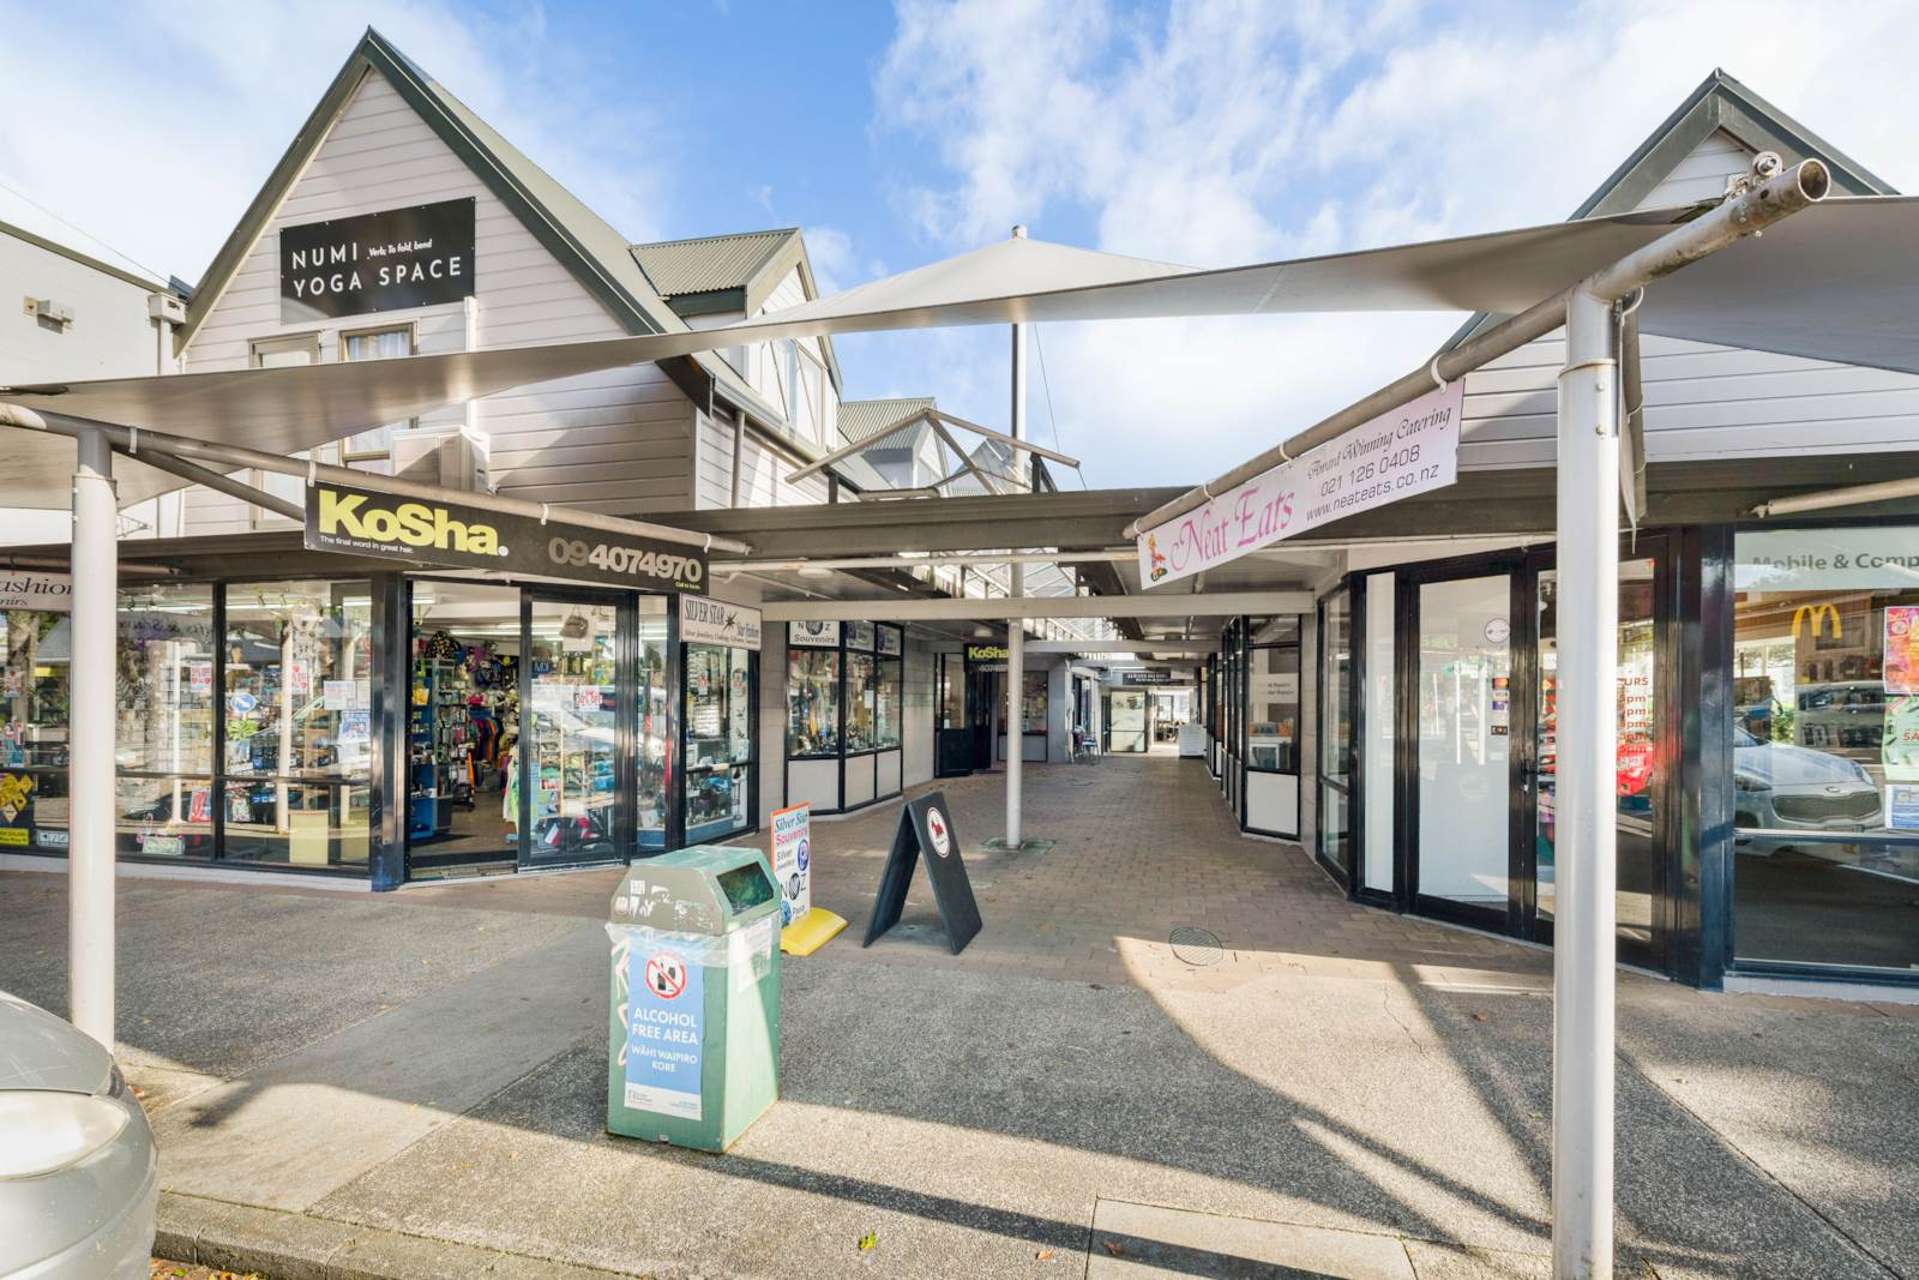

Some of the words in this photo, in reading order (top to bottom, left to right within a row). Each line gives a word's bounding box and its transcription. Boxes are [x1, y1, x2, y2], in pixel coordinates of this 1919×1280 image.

[292, 242, 357, 270] NUMI
[293, 272, 362, 298] YOGA
[379, 256, 462, 286] SPACE
[1342, 431, 1394, 461] Winning
[1396, 407, 1452, 440] Catering
[1320, 475, 1343, 497] 021
[1351, 462, 1375, 487] 126
[1379, 443, 1420, 475] 0408
[1171, 509, 1229, 572] Neat
[1234, 486, 1295, 547] Eats
[320, 535, 336, 544] The
[352, 540, 371, 549] word
[372, 542, 380, 550] in
[1753, 553, 1827, 570] Mobile
[1833, 554, 1849, 569] &
[685, 599, 709, 623] SILVER
[709, 603, 725, 626] STAR
[794, 633, 835, 644] Souvenirs
[968, 646, 1009, 659] KoSha
[776, 813, 796, 831] Silver
[634, 1008, 697, 1028] ALCOHOL
[632, 1024, 661, 1039] FREE
[663, 1029, 698, 1045] AREA
[652, 1060, 676, 1073] KORE
[657, 1049, 698, 1064] WAIPIRO
